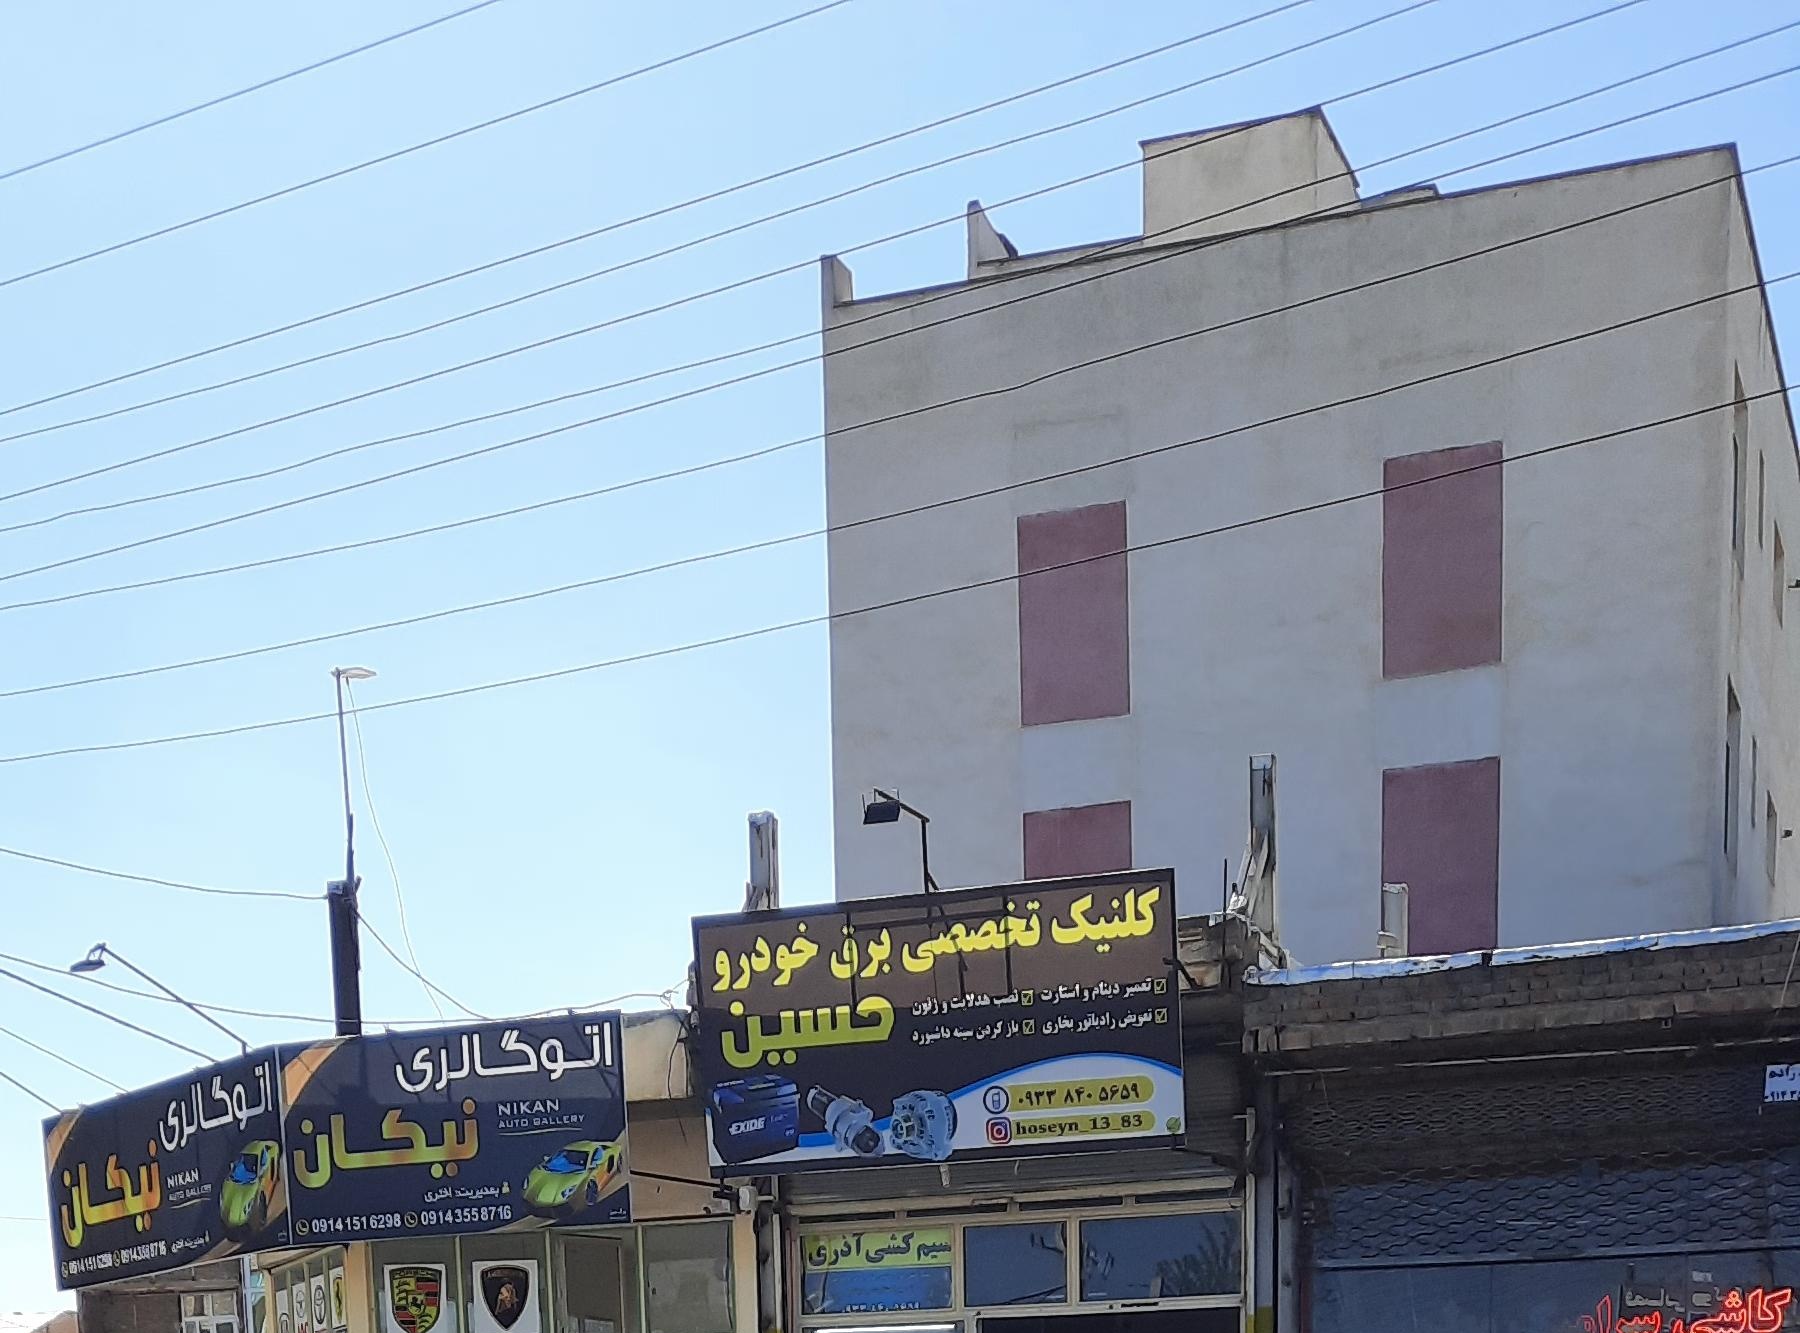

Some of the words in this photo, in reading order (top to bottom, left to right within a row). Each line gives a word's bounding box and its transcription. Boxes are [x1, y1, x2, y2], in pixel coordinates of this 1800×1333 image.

[1051, 886, 1161, 952] کلنیک
[902, 899, 1041, 973] تخصصی
[712, 921, 819, 992] خودرو
[830, 923, 892, 980] برق
[993, 989, 1019, 1006] نصب
[1040, 983, 1080, 1004] استارت
[1081, 988, 1089, 1001] و
[1092, 981, 1120, 1000] دینام
[1123, 978, 1152, 998] تعمیر
[941, 1001, 948, 1014] و
[1118, 1009, 1153, 1027] تعویض
[721, 995, 895, 1069] حسین
[975, 1020, 1003, 1040] کردن
[1006, 1019, 1019, 1037] باز
[1042, 1015, 1075, 1034] بخاری
[1076, 1011, 1116, 1032] رادیاتور
[911, 1024, 951, 1045] داشبورد
[395, 1022, 612, 1092] اتوگالری
[1018, 1088, 1057, 1107] ۰۹۳۳
[1063, 1086, 1093, 1104] ۸۴۰
[1099, 1082, 1140, 1102] ۵۶۵۹
[159, 1061, 273, 1151] اتوگالری
[499, 1099, 560, 1116] NIKAN
[499, 1118, 529, 1129] AUTO
[534, 1114, 585, 1126] GALLERY
[729, 1117, 766, 1135] EXIDE
[1016, 1114, 1143, 1136] hoseyn_13_83
[292, 1097, 479, 1188] نیکان
[167, 1168, 199, 1189] NIKAN
[61, 1139, 161, 1248] نیکان
[808, 1231, 866, 1267] آذری
[865, 1232, 915, 1264] کشی
